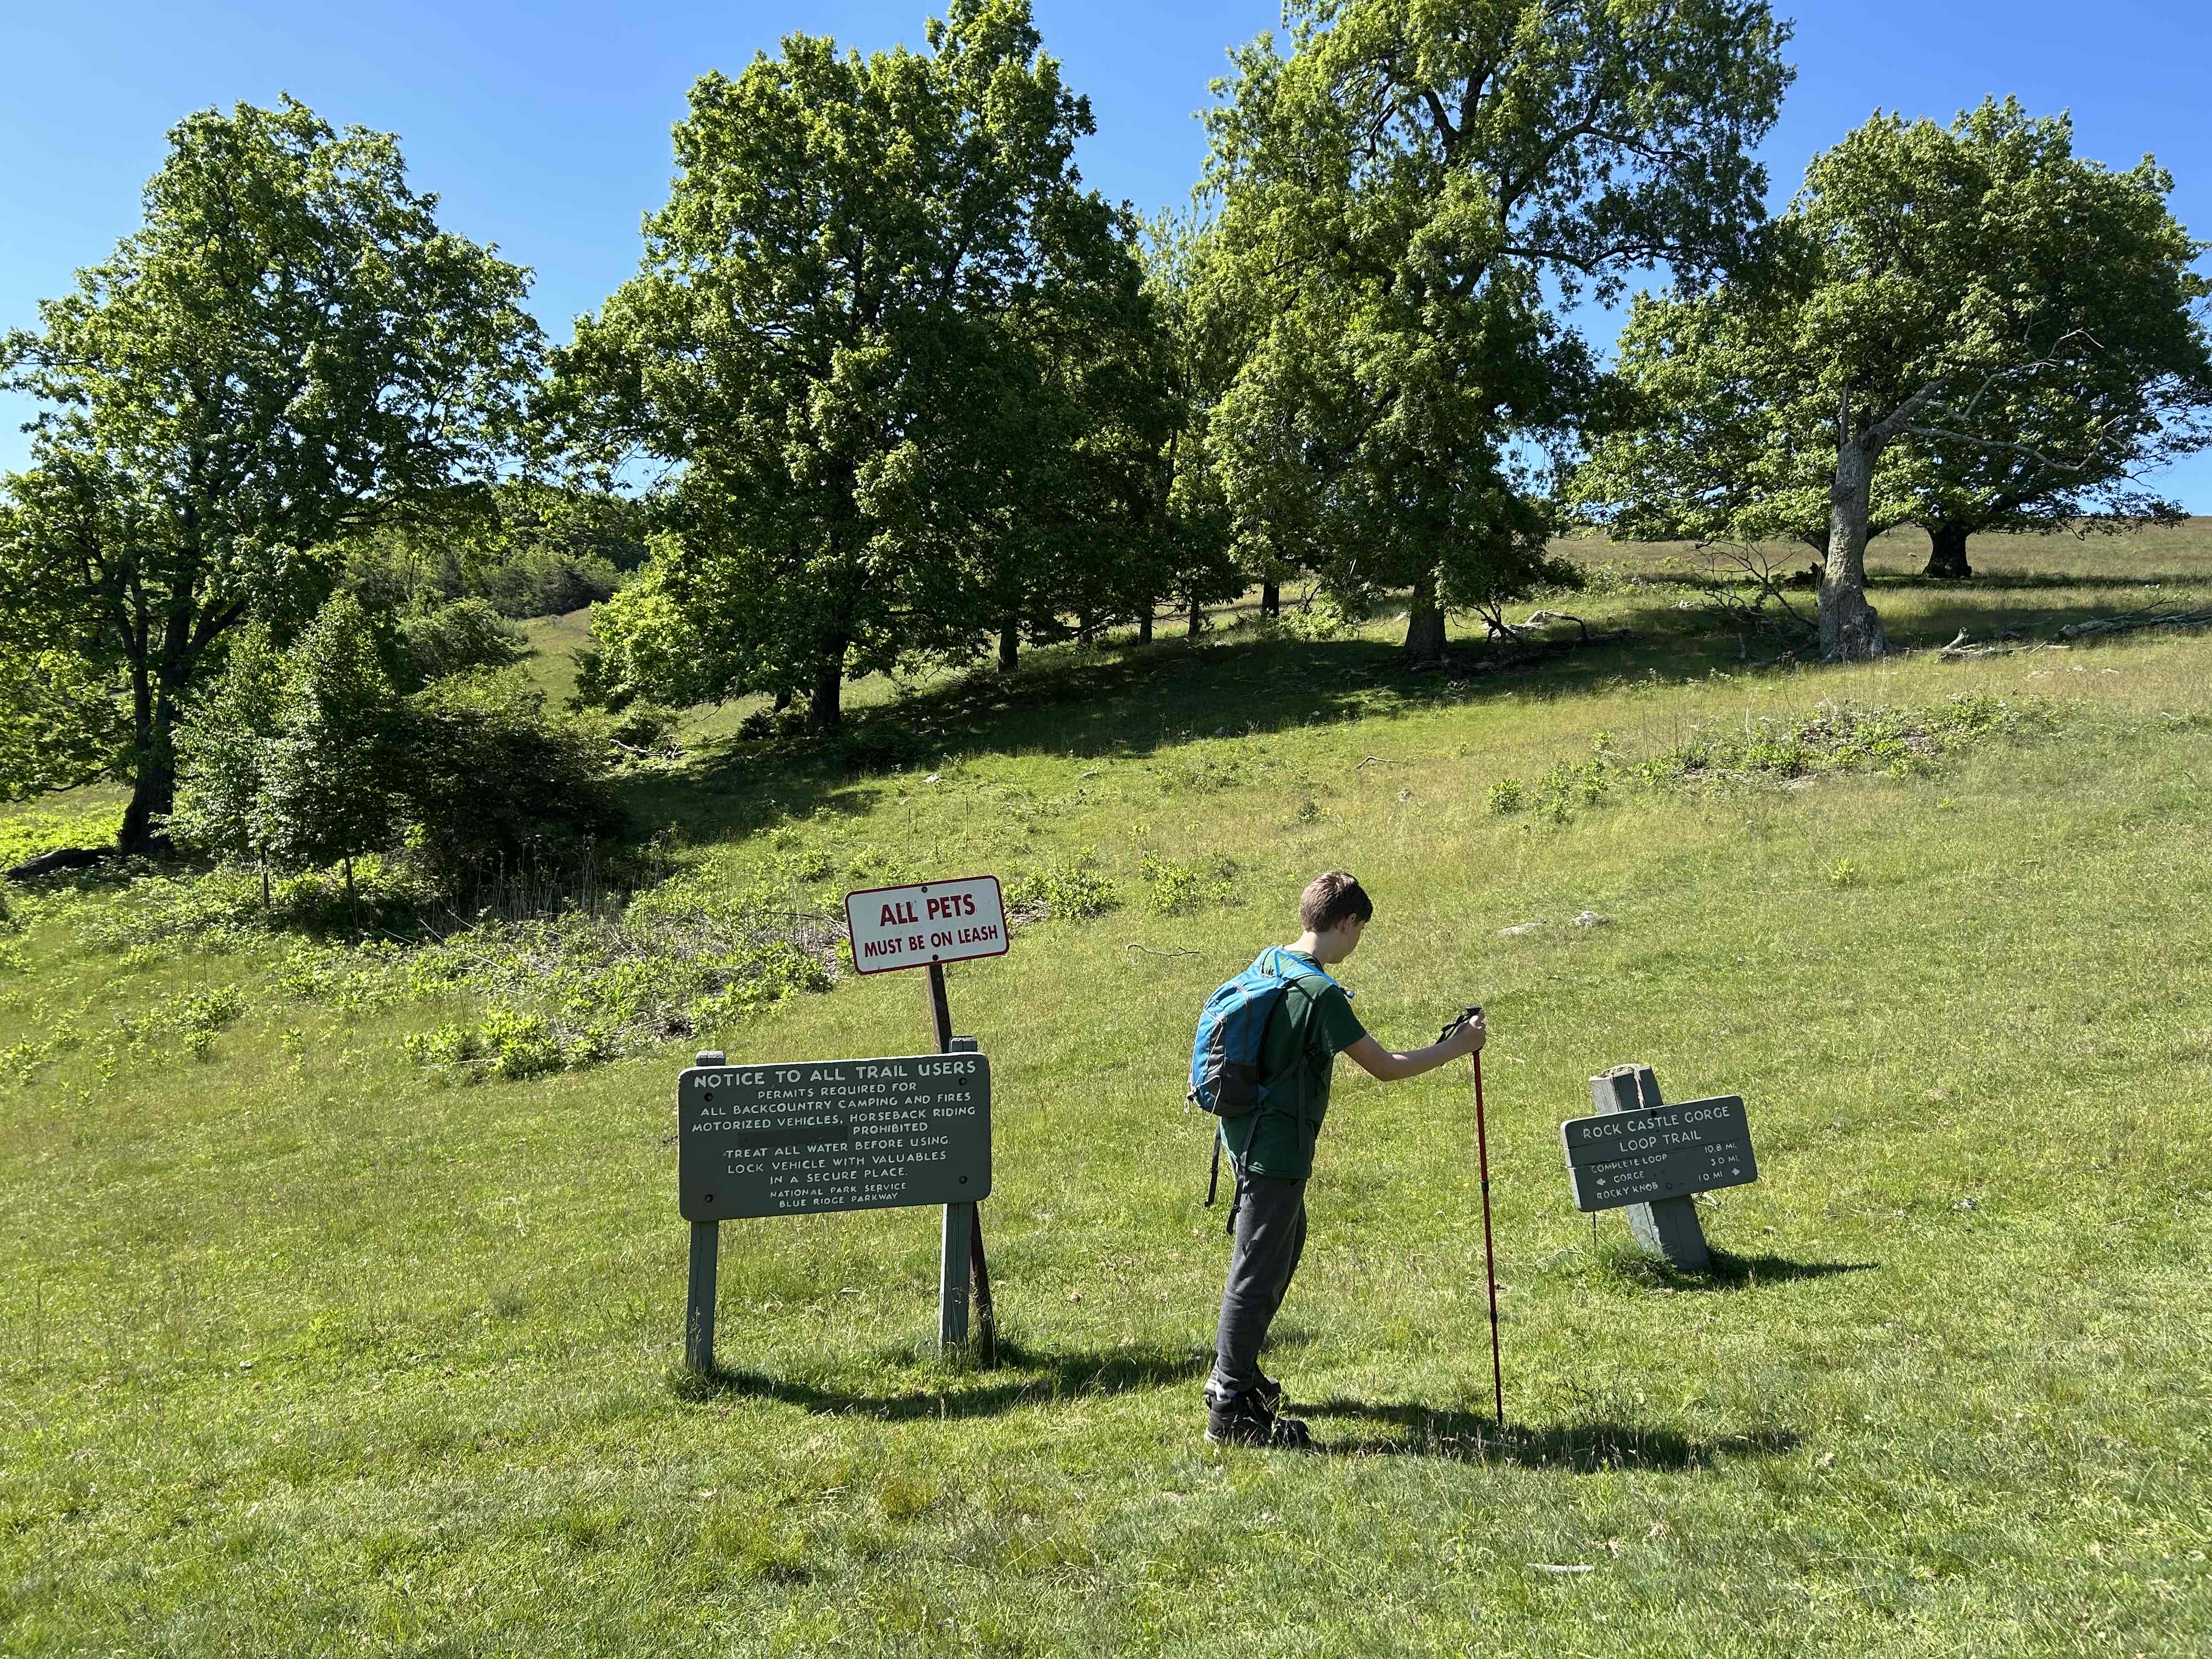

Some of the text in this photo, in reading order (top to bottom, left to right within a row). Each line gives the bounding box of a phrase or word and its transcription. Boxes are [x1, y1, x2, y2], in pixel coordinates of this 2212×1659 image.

[880, 894, 975, 927] ALL PETS
[865, 925, 998, 957] MUST BE ON LEASH
[694, 1060, 976, 1088] NOTICE TO ALL TRAIL USERS
[758, 1082, 917, 1099] PERMITS REQUIRED FOR
[701, 1092, 970, 1116] ALL BACKCOUNTRY CAMPING AND FIRES
[692, 1106, 975, 1132] MOTORIZED VEHICLES, HORSEBACK RIDING
[853, 1122, 928, 1135] PROHIBITED
[1583, 1106, 1730, 1139] ROCK CASTLE GORGE
[725, 1148, 768, 1159] TREAT
[774, 1146, 800, 1156] ALL
[808, 1142, 848, 1153] WATER
[855, 1139, 904, 1150] BEFORE
[1620, 1130, 1701, 1153] LOOP TRAIL
[727, 1152, 946, 1174] LOCK VEHICLE WITH VALUABLES
[1643, 1153, 1667, 1165] LOOP
[1705, 1144, 1722, 1154] 10.8
[770, 1167, 908, 1184] IN A SECURE PLACE.
[1613, 1171, 1645, 1183] GORGE
[770, 1182, 906, 1198] NATIONAL PARK SERVICE
[780, 1192, 898, 1207] BLUE RIDGE PARKWAY
[1596, 1187, 1629, 1199] ROCKY
[1633, 1182, 1658, 1194] KNOB
